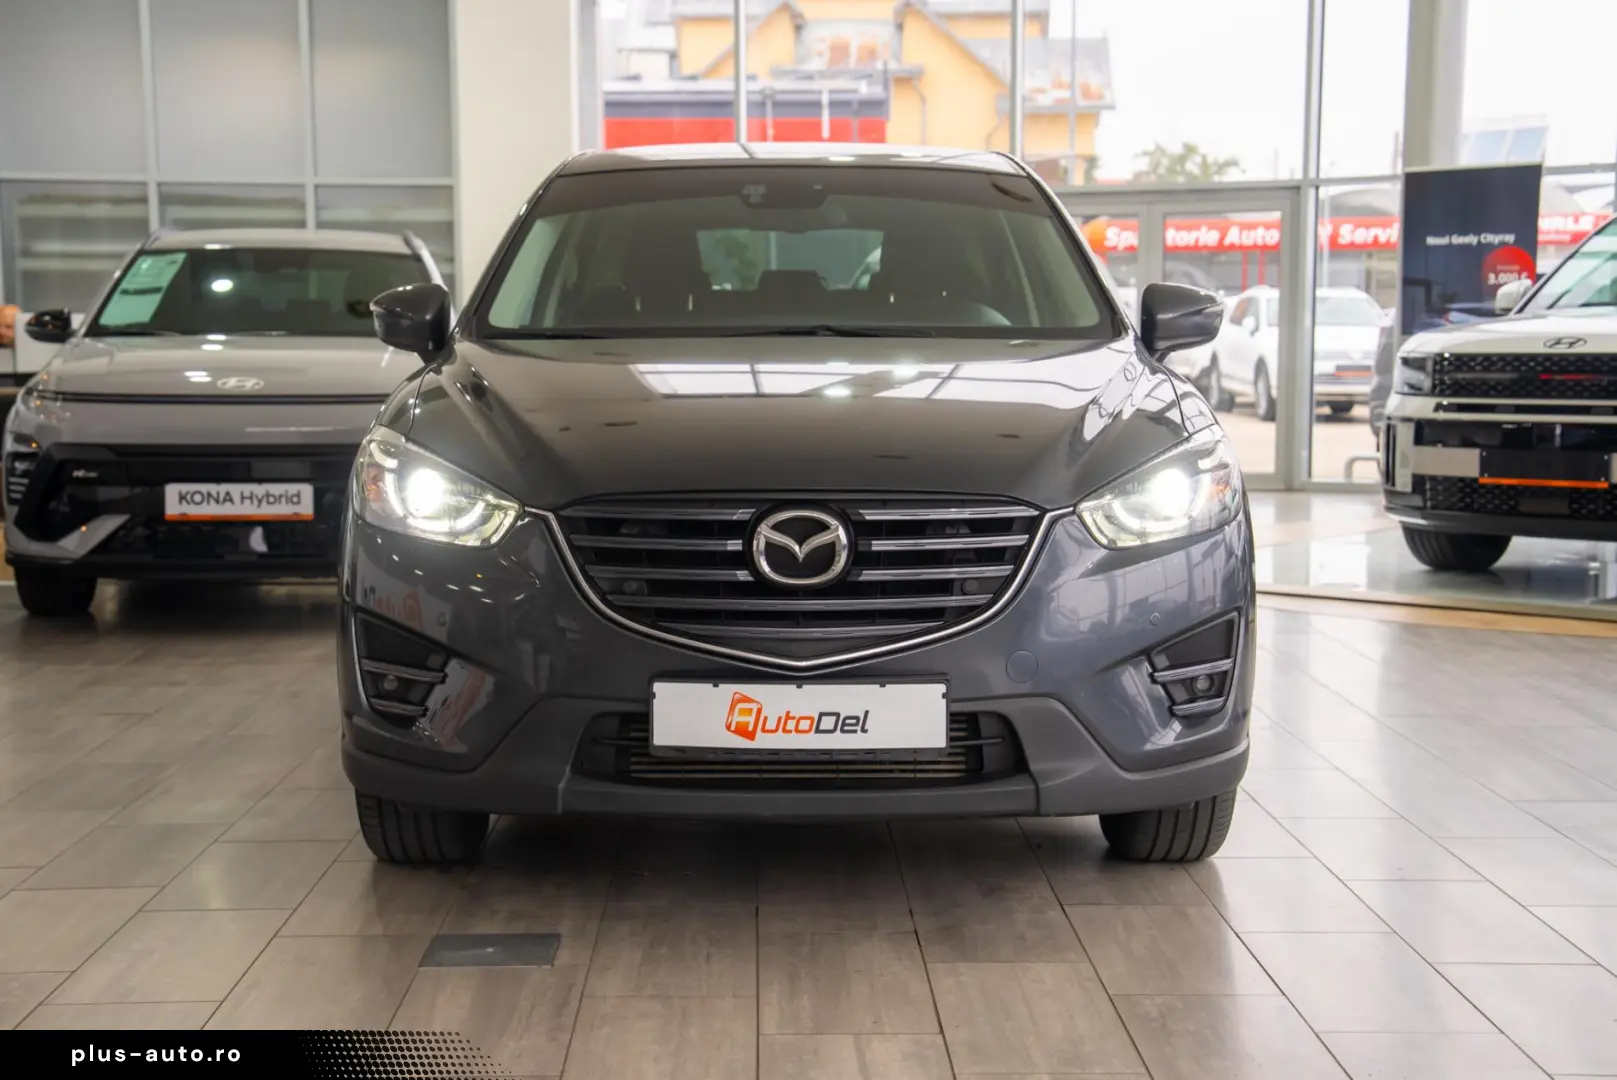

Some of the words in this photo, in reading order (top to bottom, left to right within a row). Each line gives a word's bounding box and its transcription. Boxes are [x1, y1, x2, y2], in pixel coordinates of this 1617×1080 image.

[1223, 225, 1280, 247] Auto
[178, 490, 235, 506] KONA
[240, 489, 302, 508] Hybrid
[728, 701, 870, 736] AutoDel
